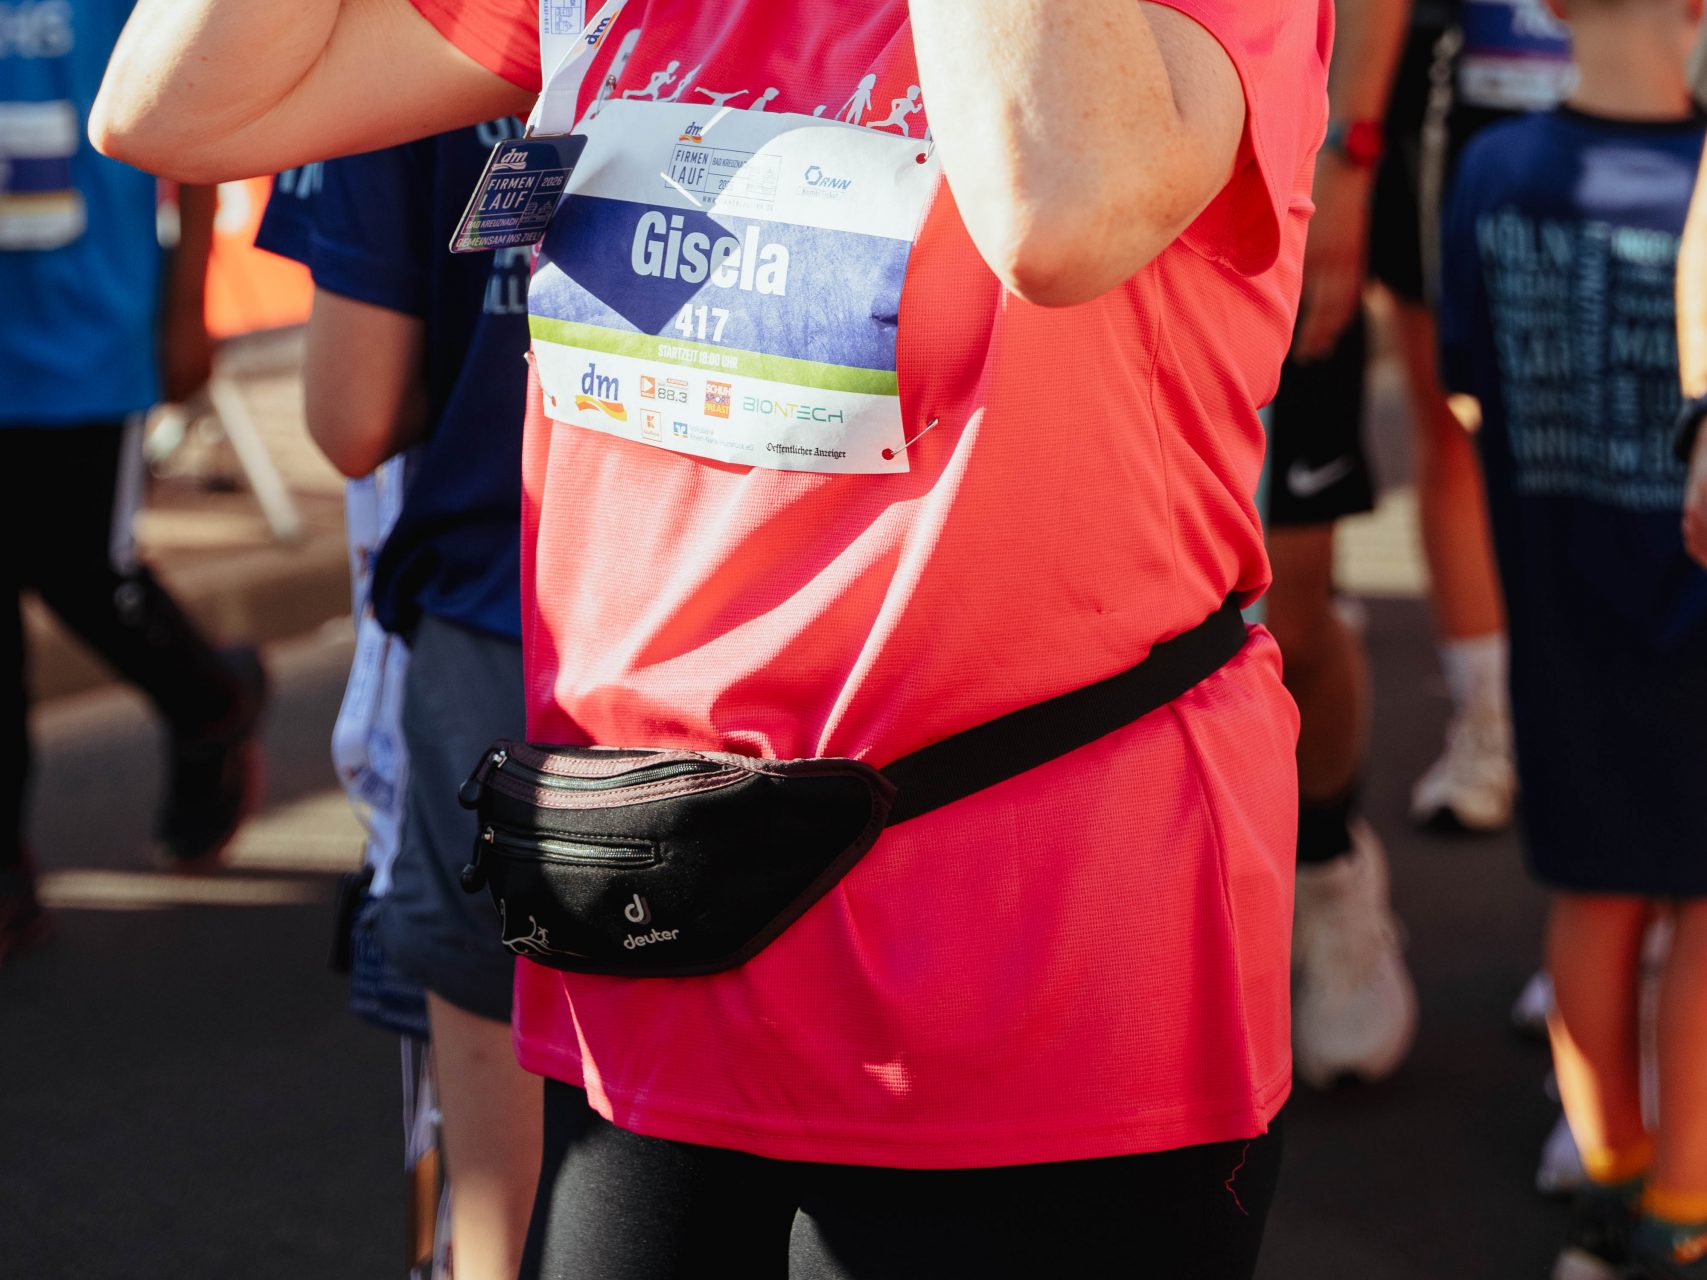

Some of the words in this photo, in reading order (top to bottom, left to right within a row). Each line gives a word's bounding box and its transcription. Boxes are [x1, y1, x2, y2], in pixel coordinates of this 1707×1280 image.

[585, 17, 611, 45] dm
[500, 148, 529, 163] dm
[675, 149, 710, 166] FIRMEN
[487, 176, 535, 191] FIRMEN
[670, 165, 706, 187] LAUF
[478, 191, 528, 211] LAUF
[631, 210, 790, 297] Gisela
[674, 303, 730, 342] 417
[581, 363, 620, 401] dm
[657, 387, 688, 404] 88.3
[813, 447, 847, 460] Anzeiger
[623, 928, 679, 950] deuter
